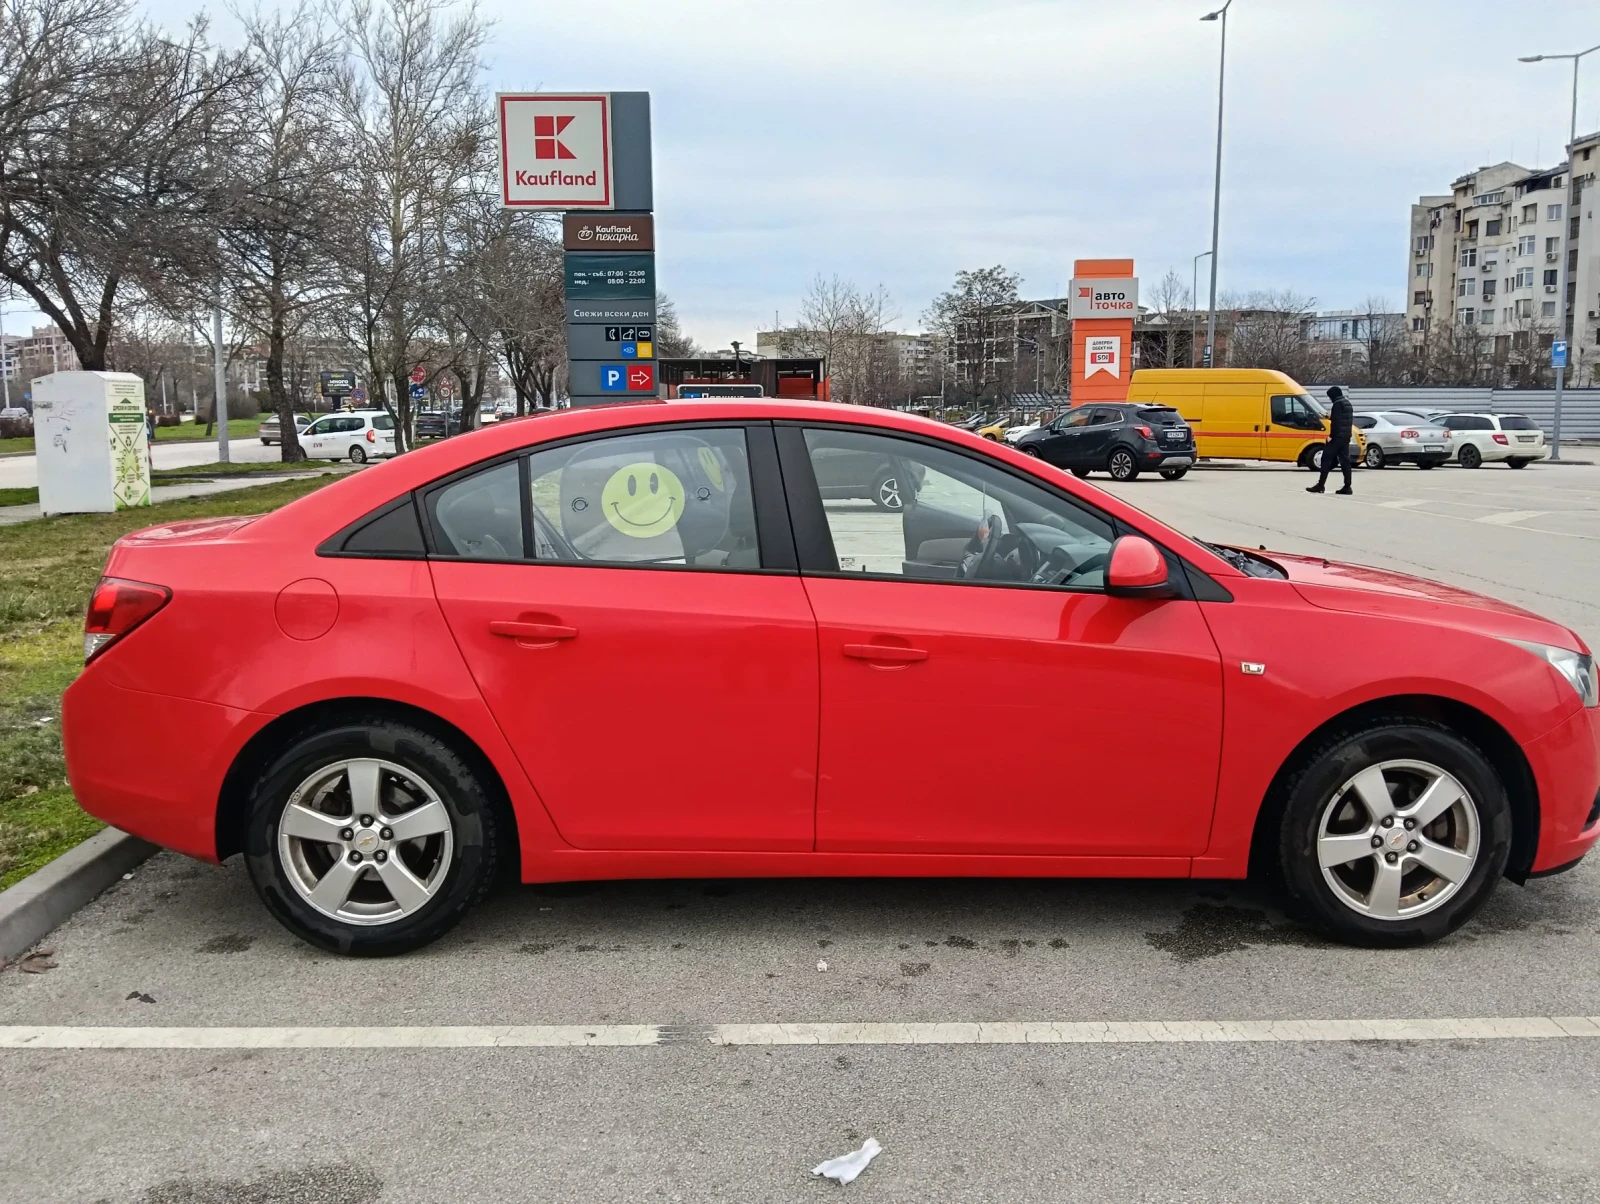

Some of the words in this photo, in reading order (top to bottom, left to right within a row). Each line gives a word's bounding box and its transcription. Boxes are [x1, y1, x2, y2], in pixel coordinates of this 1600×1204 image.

[515, 170, 597, 186] Kaufland
[595, 225, 631, 233] Kaufland
[595, 233, 639, 242] пекарна
[1095, 292, 1126, 301] авто
[1095, 302, 1133, 310] точка
[573, 309, 603, 318] Свежи
[608, 370, 620, 387] P
